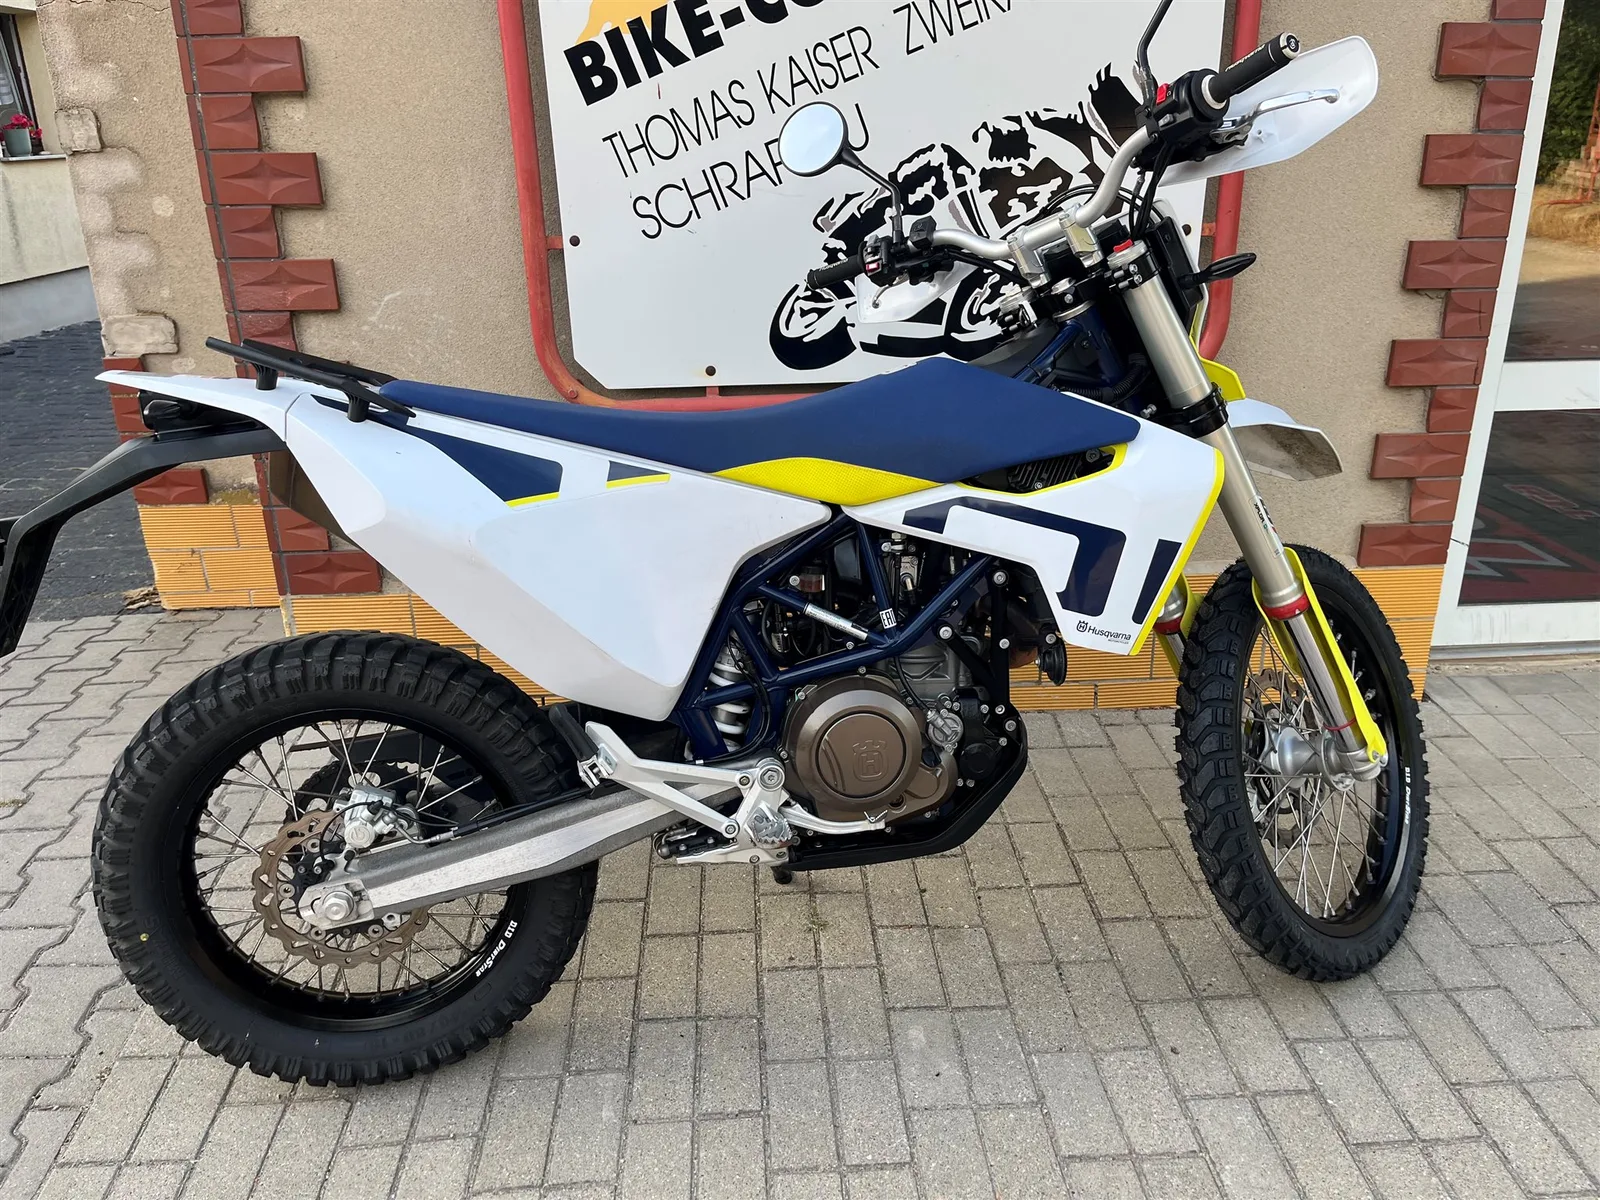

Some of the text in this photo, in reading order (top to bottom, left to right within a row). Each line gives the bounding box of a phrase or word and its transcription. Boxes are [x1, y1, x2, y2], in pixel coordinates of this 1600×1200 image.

[601, 79, 755, 178] THOMAS
[756, 26, 880, 114] KAISER
[1088, 626, 1131, 640] Husqvarna
